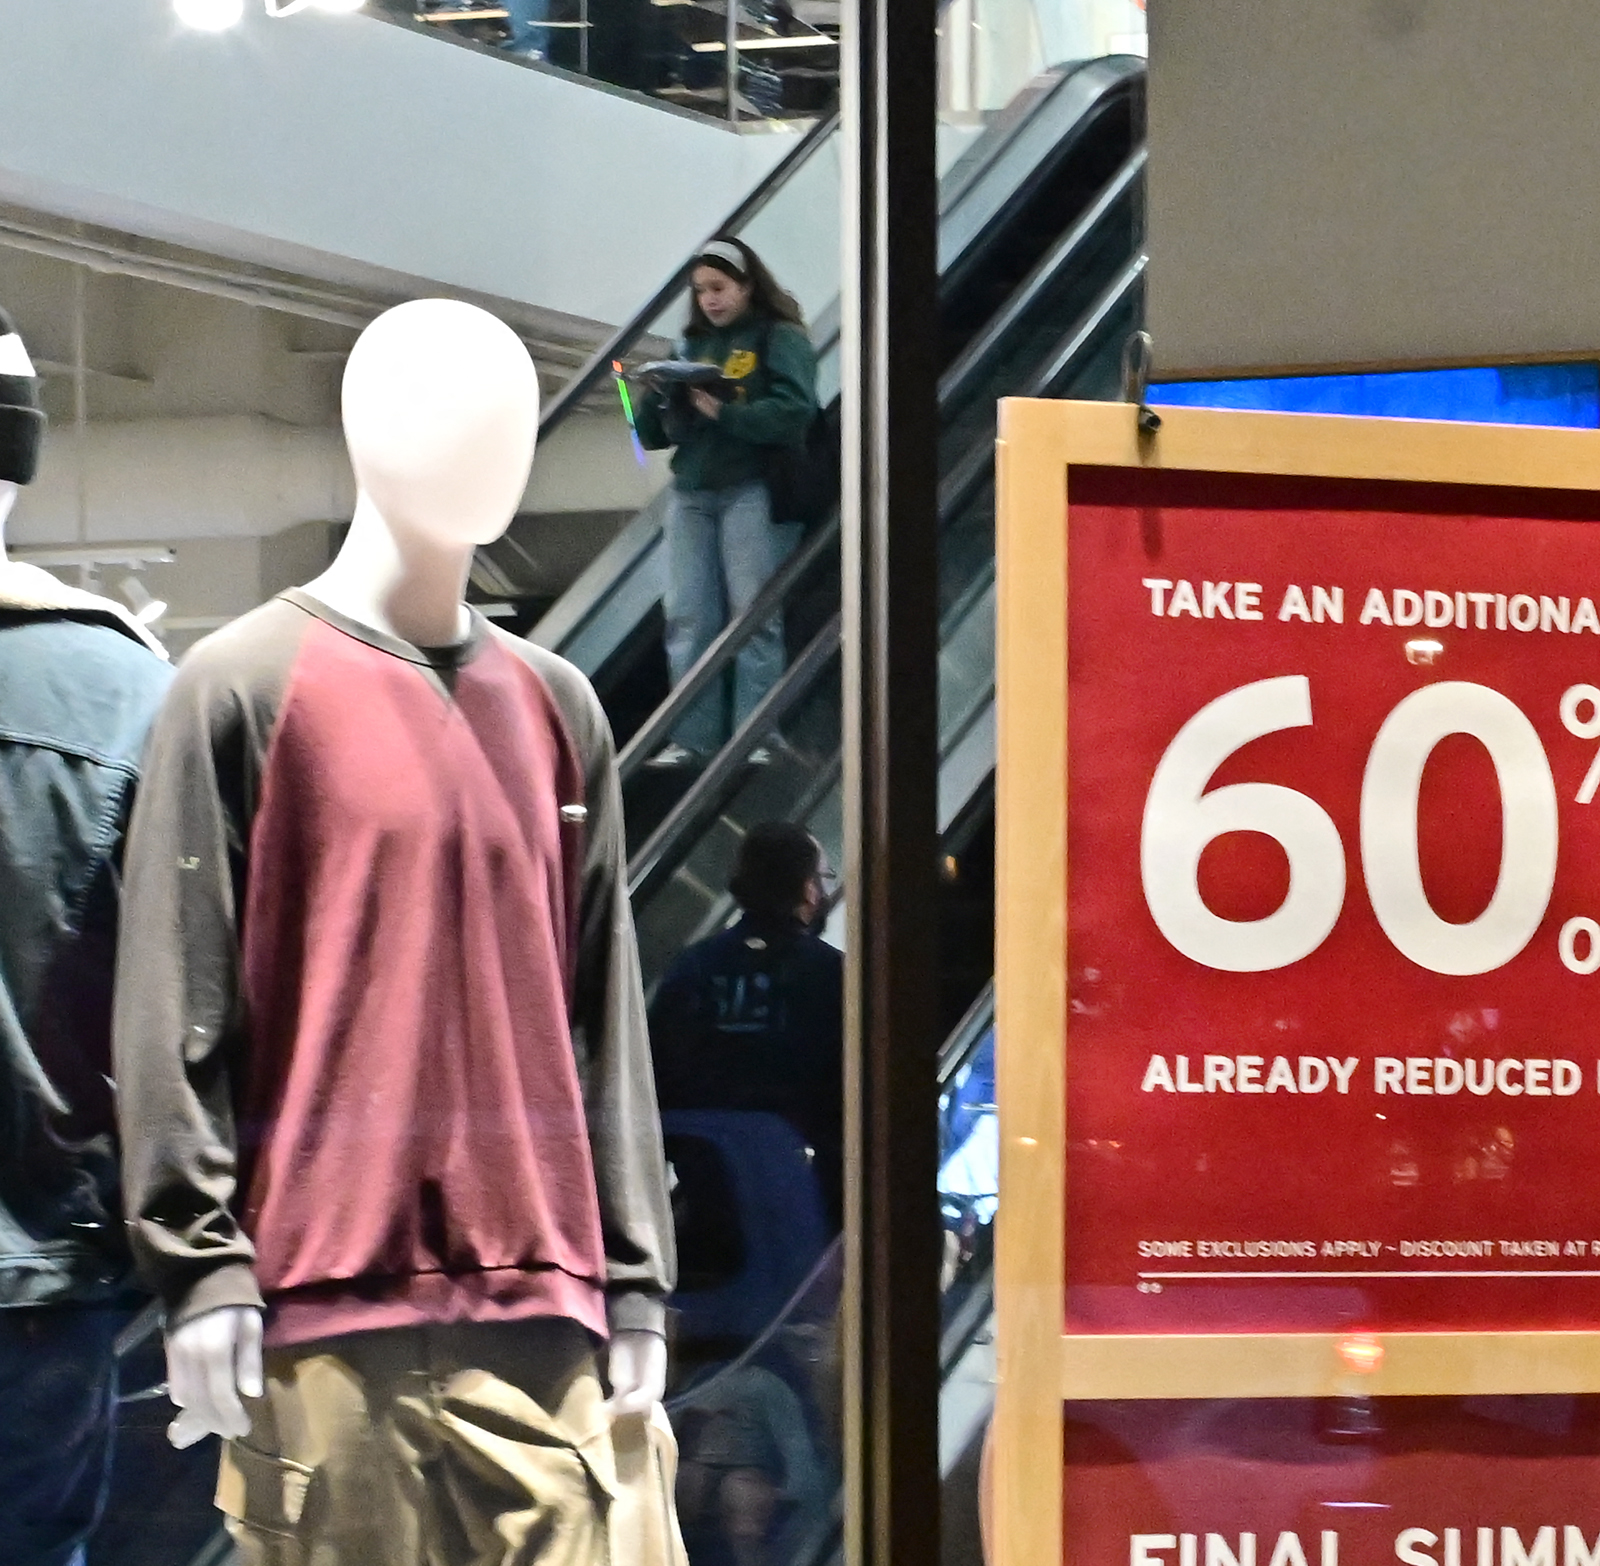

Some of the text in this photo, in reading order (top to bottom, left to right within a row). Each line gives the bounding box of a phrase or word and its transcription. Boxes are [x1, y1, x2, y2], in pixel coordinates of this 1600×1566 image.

[1143, 577, 1262, 622] TAKE
[1278, 583, 1344, 624] AN
[1141, 1055, 1359, 1094] ALREADY
[1373, 1057, 1583, 1097] REDUCED
[1137, 1240, 1194, 1258] SOME
[1197, 1240, 1317, 1258] EXCLUSIONS
[1320, 1240, 1383, 1258] APPLY
[1400, 1240, 1494, 1258] DISCOUNT
[1498, 1240, 1560, 1257] TAKEN
[1563, 1240, 1589, 1257] AT
